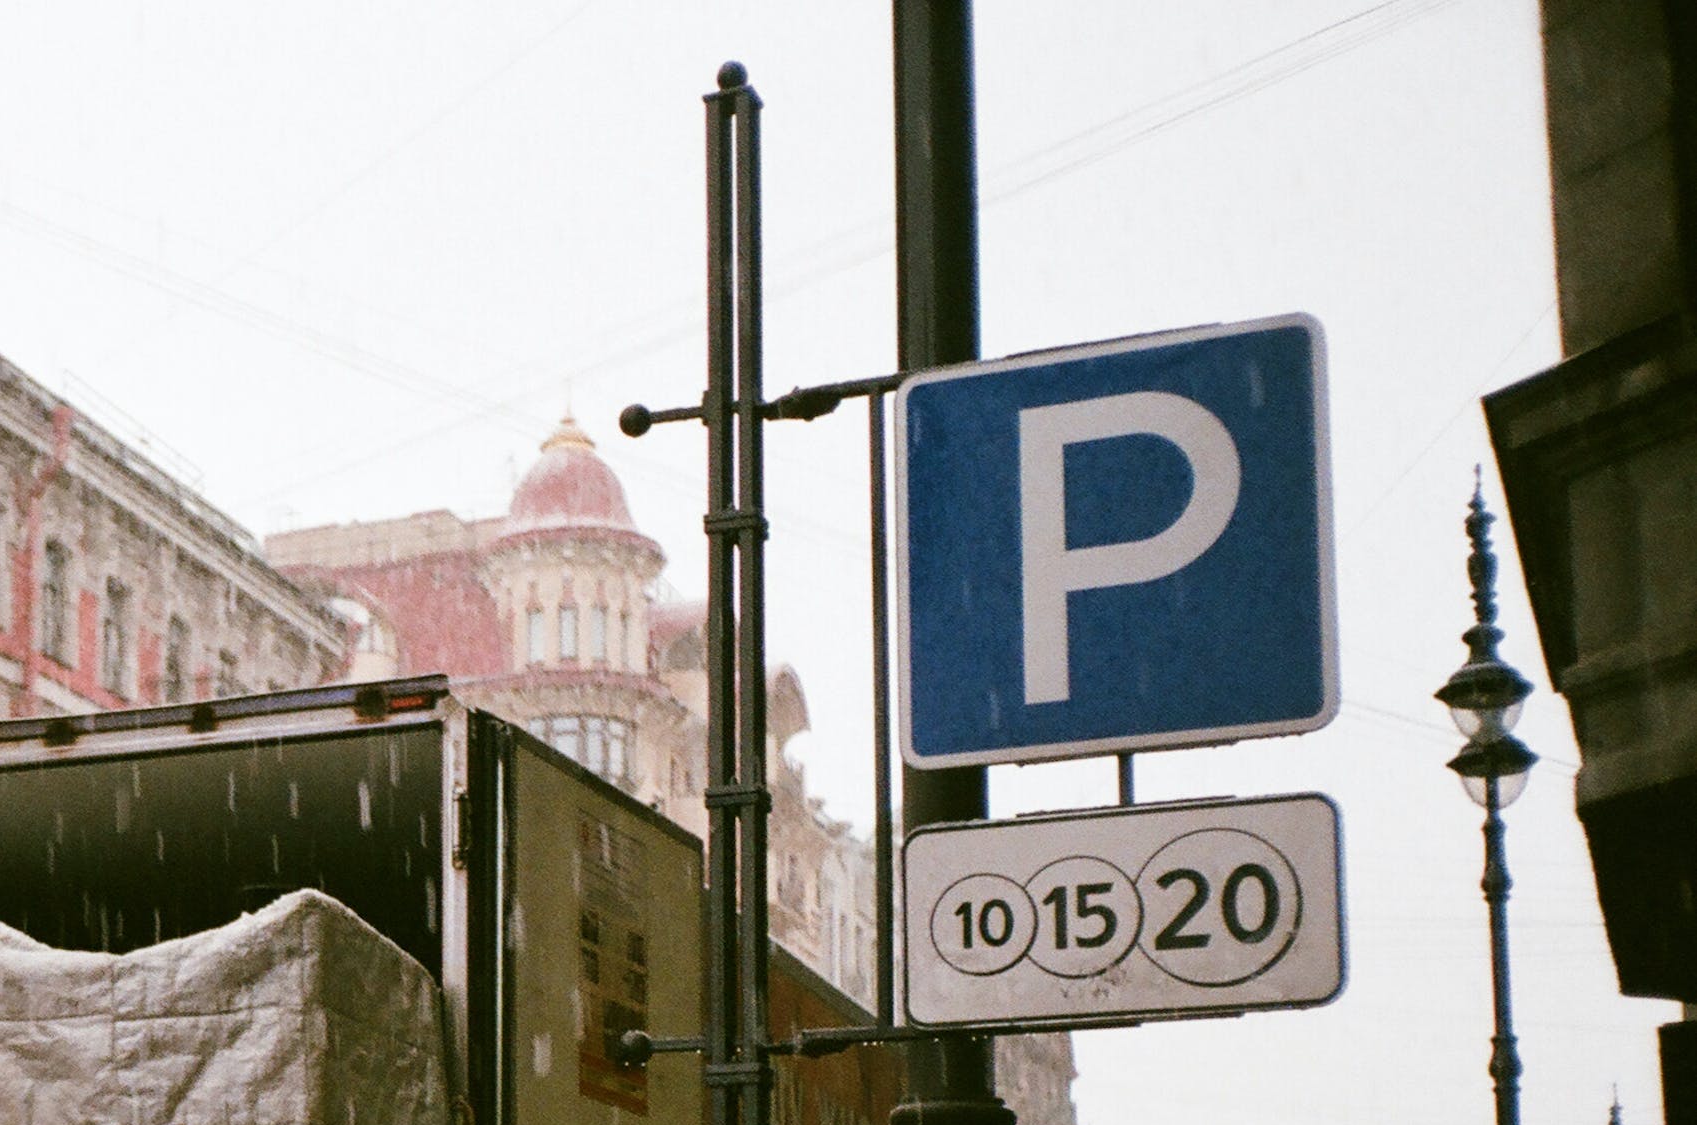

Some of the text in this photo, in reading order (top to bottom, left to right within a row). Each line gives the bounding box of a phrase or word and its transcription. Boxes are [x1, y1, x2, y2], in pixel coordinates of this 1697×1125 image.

[1018, 391, 1242, 707] P
[954, 861, 1282, 952] 10 15 20
